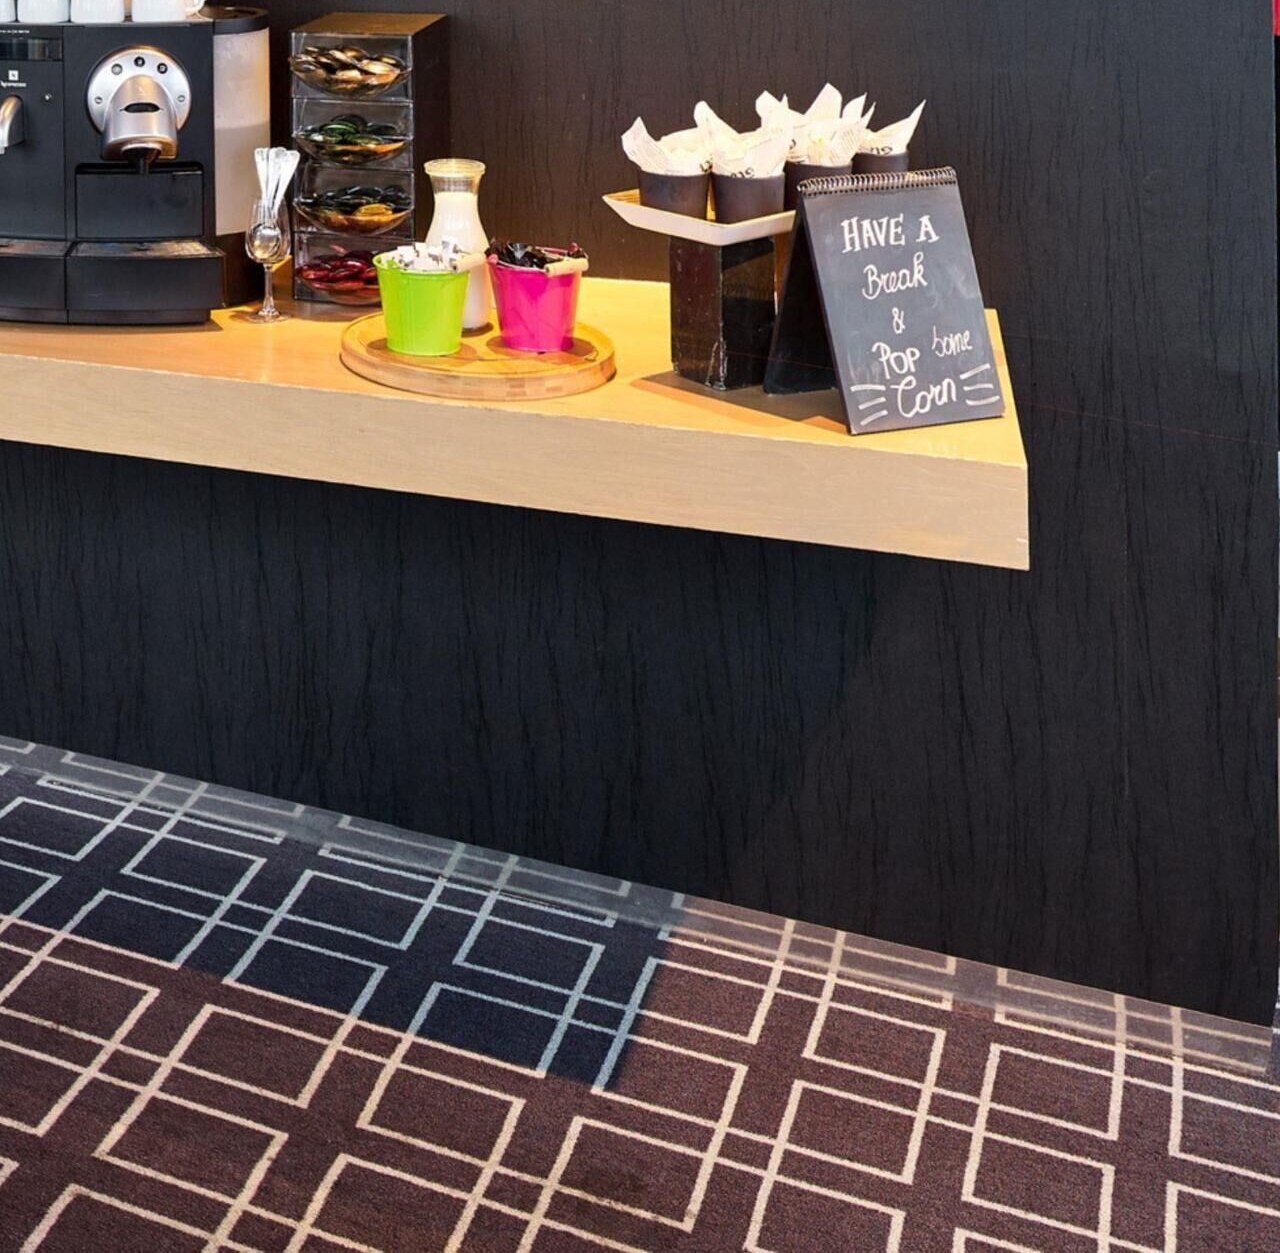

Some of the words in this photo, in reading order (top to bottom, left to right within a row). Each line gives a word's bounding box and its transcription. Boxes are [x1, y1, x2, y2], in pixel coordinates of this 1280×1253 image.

[841, 212, 906, 254] HAVE
[915, 215, 940, 243] A
[862, 251, 928, 300] Break
[891, 306, 906, 334] &
[890, 375, 957, 418] Corn
